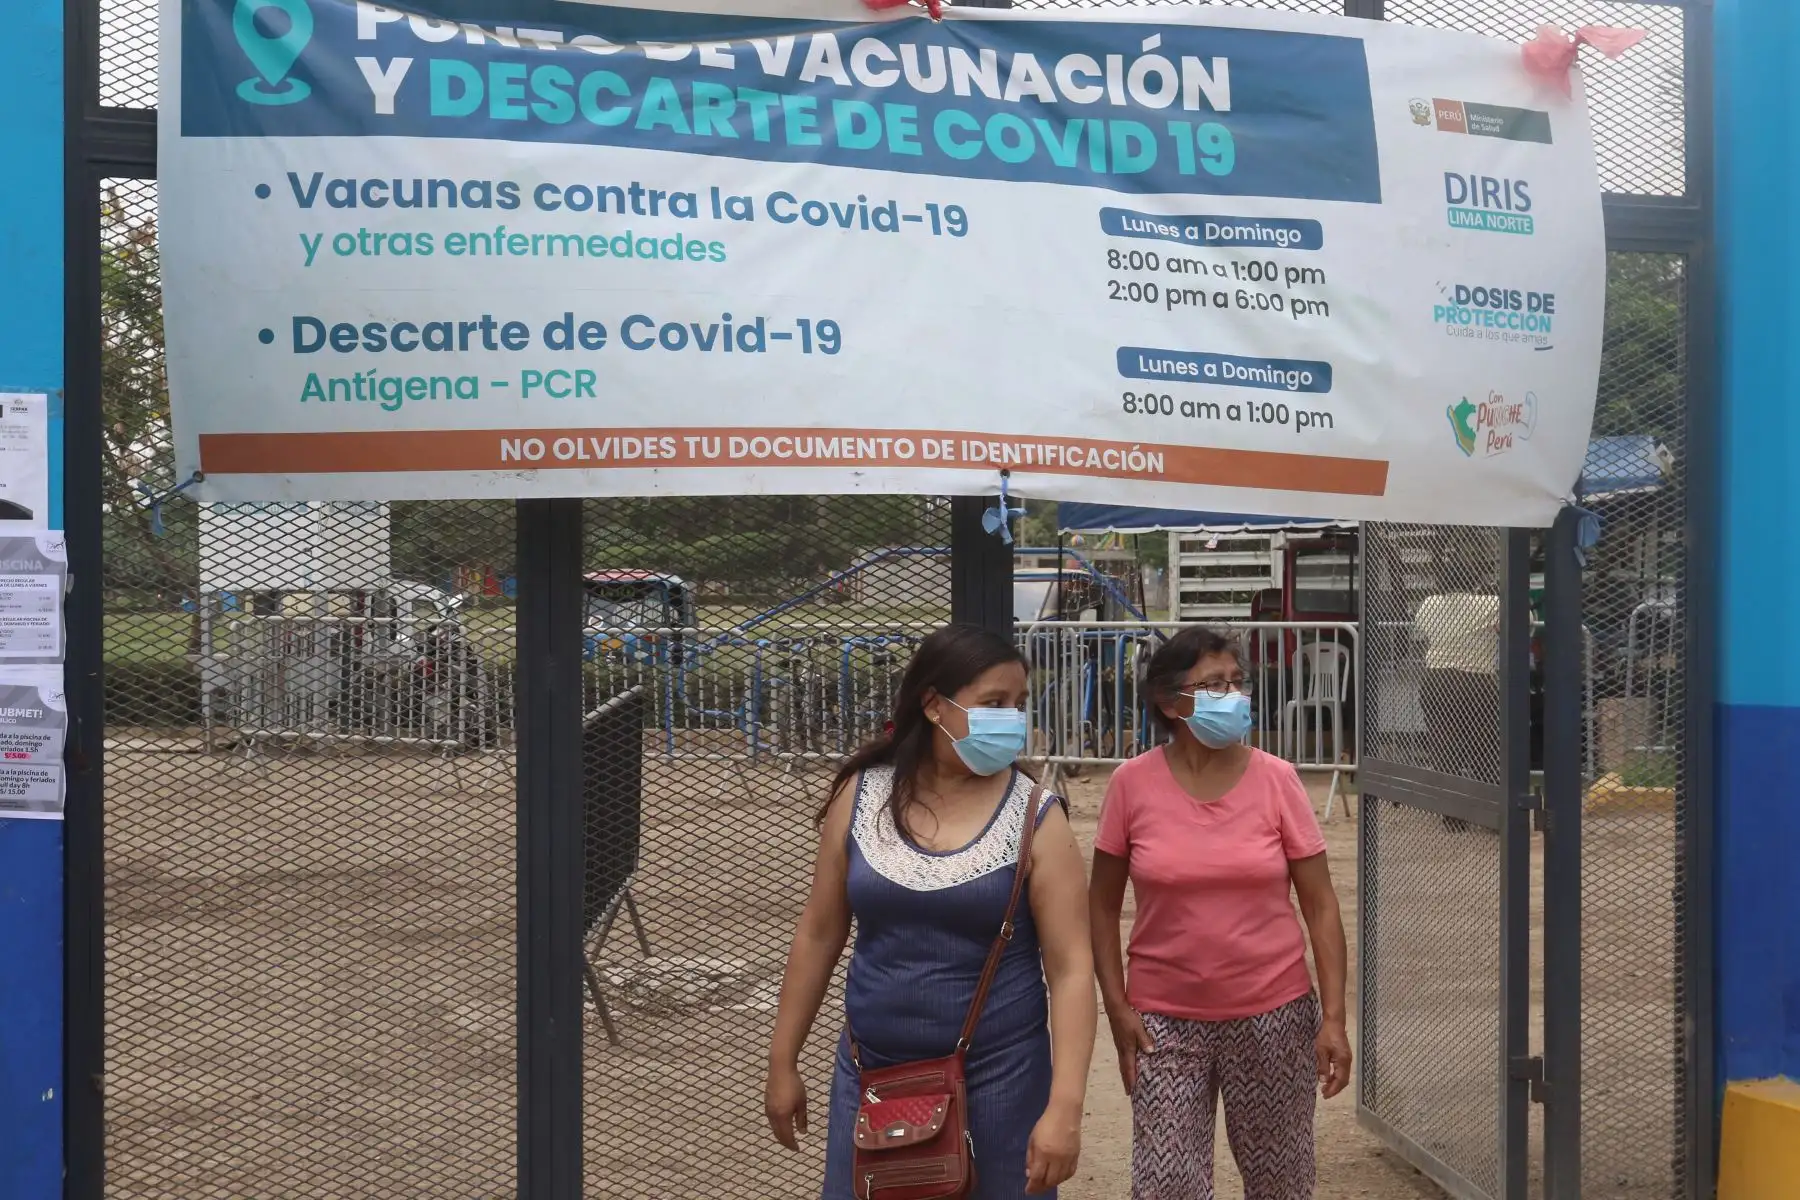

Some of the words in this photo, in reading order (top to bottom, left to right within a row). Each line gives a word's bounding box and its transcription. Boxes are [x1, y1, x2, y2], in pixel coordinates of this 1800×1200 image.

[746, 33, 1231, 112] VACUNACIÓN
[354, 56, 414, 115] Y
[429, 58, 822, 147] DESCARTE
[832, 99, 923, 156] DE
[933, 108, 1158, 175] COVID
[1167, 120, 1236, 177] 19
[1438, 109, 1462, 122] PERÚ
[1470, 114, 1504, 125] Ministerio
[1471, 122, 1480, 131] de
[1481, 124, 1500, 132] Salud
[286, 171, 522, 209] Vacunas
[533, 181, 699, 219] contra
[710, 186, 755, 222] la
[765, 190, 969, 238] Covid-19
[1444, 171, 1532, 213] DIRIS
[1121, 215, 1180, 238] Lunes
[1184, 226, 1199, 240] a
[1205, 222, 1302, 247] Domingo
[1449, 210, 1484, 226] LIMA
[1486, 214, 1532, 232] NORTE
[299, 232, 324, 267] y
[332, 227, 435, 257] otras
[444, 225, 727, 263] enfermedades
[1106, 248, 1160, 272] 8:00
[1165, 256, 1208, 275] am
[1212, 262, 1229, 278] a
[1230, 260, 1279, 282] 1:00
[1284, 265, 1326, 288] pm
[1107, 279, 1159, 304] 2:00
[1165, 287, 1207, 311] pm
[1212, 291, 1229, 309] a
[1235, 288, 1284, 313] 6:00
[1290, 297, 1330, 320] pm
[1455, 284, 1523, 311] DOSIS
[1526, 291, 1555, 315] DE
[292, 314, 531, 354] Descarte
[543, 311, 608, 351] de
[620, 312, 842, 355] Covid-19
[1446, 324, 1475, 338] Cuida
[1477, 329, 1483, 339] a
[1485, 328, 1500, 340] los
[1502, 331, 1520, 343] que
[1521, 334, 1548, 345] amas
[300, 368, 479, 412] Antígena
[521, 369, 598, 399] PCR
[1138, 354, 1199, 376] Lunes
[1203, 364, 1217, 378] a
[1222, 361, 1313, 390] Domingo
[1122, 391, 1174, 416] 8:00
[1179, 399, 1220, 420] am
[1226, 404, 1241, 422] a
[1246, 401, 1290, 425] 1:00
[1295, 409, 1334, 433] pm
[1489, 389, 1503, 404] Con
[500, 437, 546, 461] NO
[552, 436, 677, 460] OLVIDES
[683, 436, 722, 459] TU
[728, 436, 916, 460] DOCUMENTO
[921, 438, 955, 461] DE
[961, 440, 1165, 474] IDENTIFICACIÓN
[1486, 429, 1513, 454] Perú
